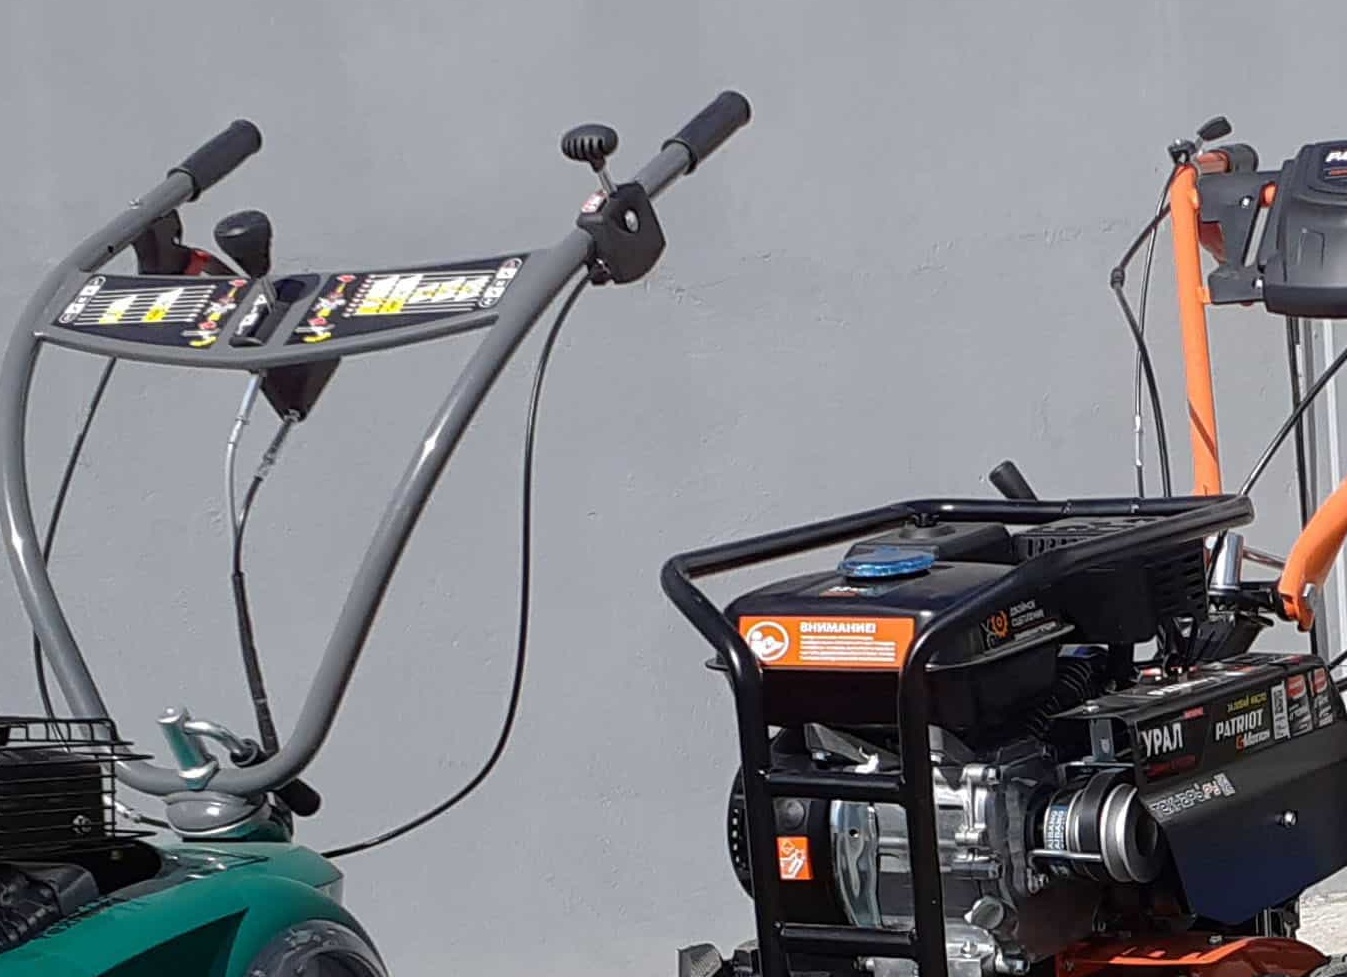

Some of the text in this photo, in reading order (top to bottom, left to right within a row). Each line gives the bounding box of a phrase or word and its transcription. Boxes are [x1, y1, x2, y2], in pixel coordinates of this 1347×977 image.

[800, 622, 877, 634] ВНИМАНИЕ!
[1141, 722, 1183, 757] УРАЛ
[1215, 708, 1264, 741] PATRIOT
